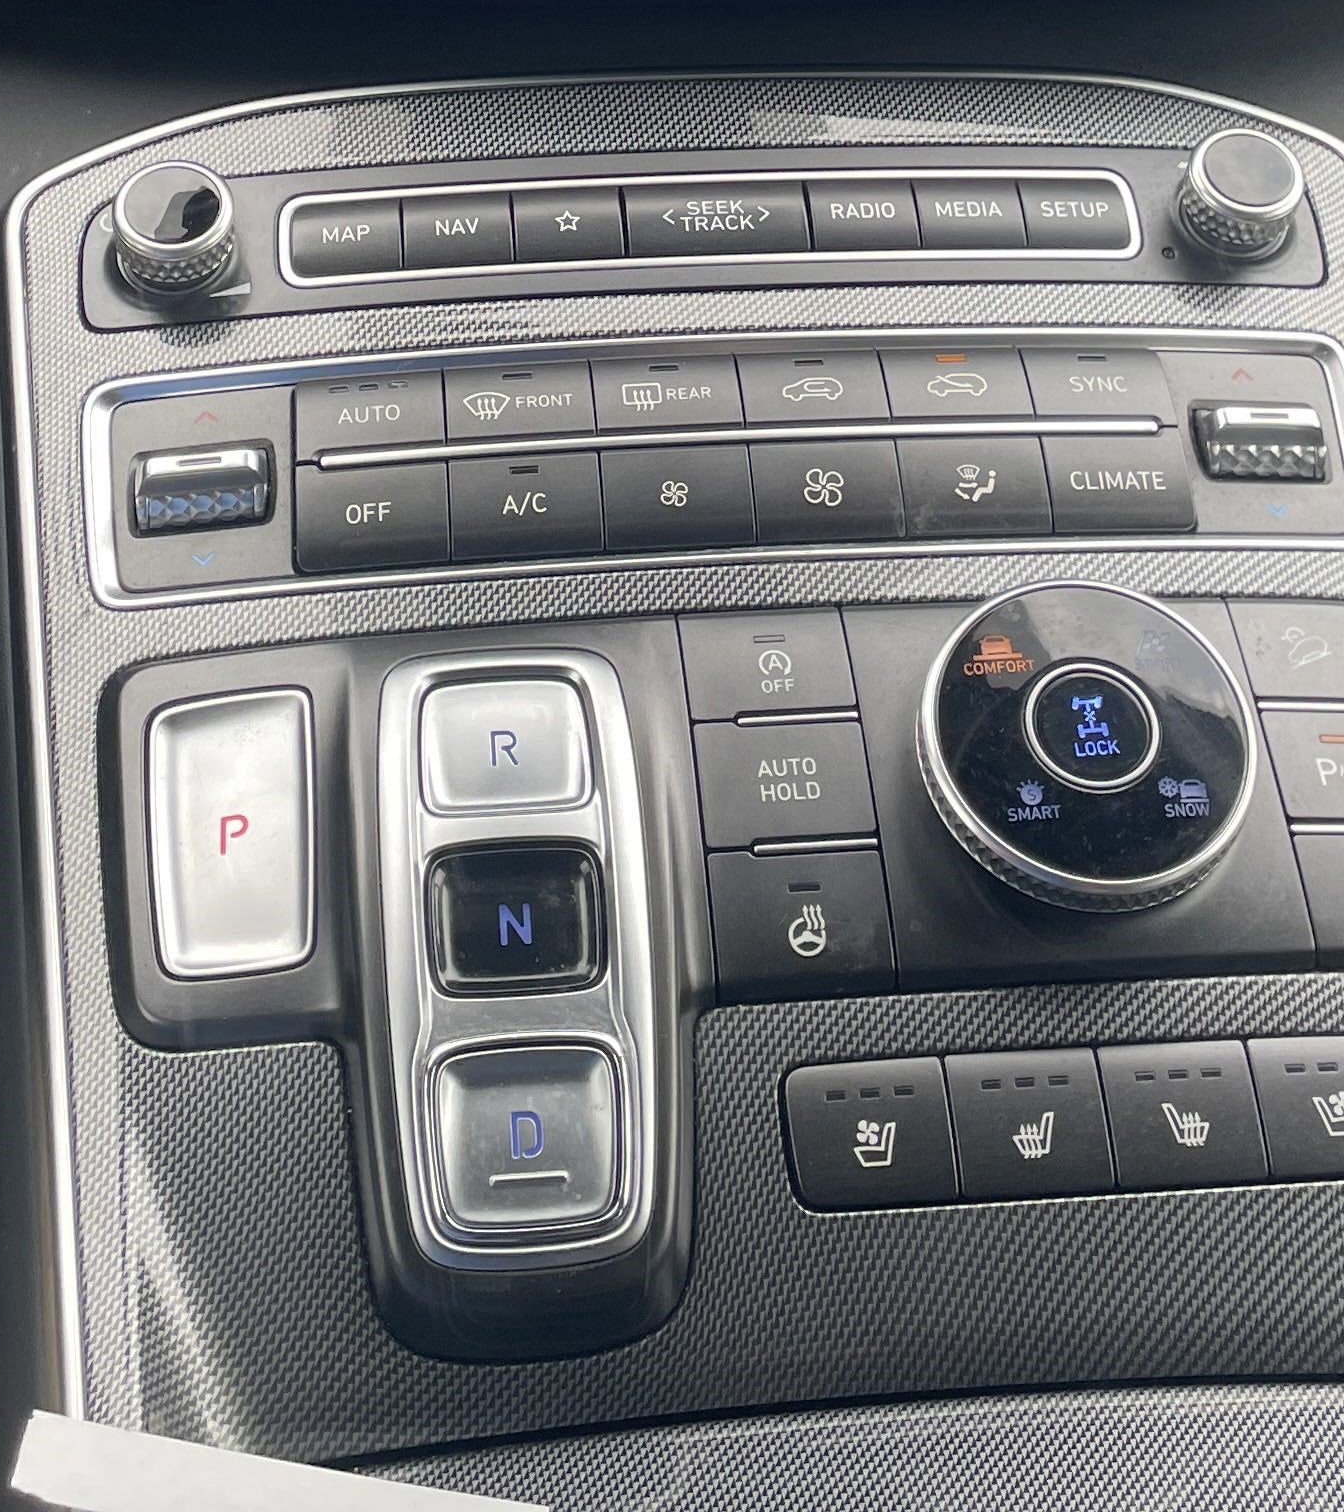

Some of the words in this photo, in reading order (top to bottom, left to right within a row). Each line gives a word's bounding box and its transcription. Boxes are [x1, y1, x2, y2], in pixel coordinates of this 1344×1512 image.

[686, 199, 745, 216] SEEK
[830, 201, 896, 220] RADIO
[935, 201, 1003, 218] MEDIA
[1040, 201, 1109, 219] SETUP
[435, 217, 479, 236] NAV
[680, 214, 755, 232] TRACK
[321, 225, 371, 245] MAP
[666, 385, 712, 402] REAR
[1068, 375, 1128, 394] SYNC
[515, 392, 573, 409] FRONT
[337, 404, 401, 426] AUTO
[1069, 470, 1167, 491] CLIMATE
[345, 501, 392, 525] OFF
[502, 491, 548, 517] A/C
[962, 659, 1036, 676] COMFORT
[761, 678, 795, 694] OFF
[490, 730, 519, 768] R
[1073, 739, 1121, 758] LOCK
[758, 757, 818, 779] AUTO
[760, 781, 821, 803] HOLD
[1007, 804, 1062, 822] SMART
[1164, 803, 1211, 818] SNOW
[219, 814, 249, 856] P
[497, 902, 533, 946] N
[509, 1110, 544, 1159] D
